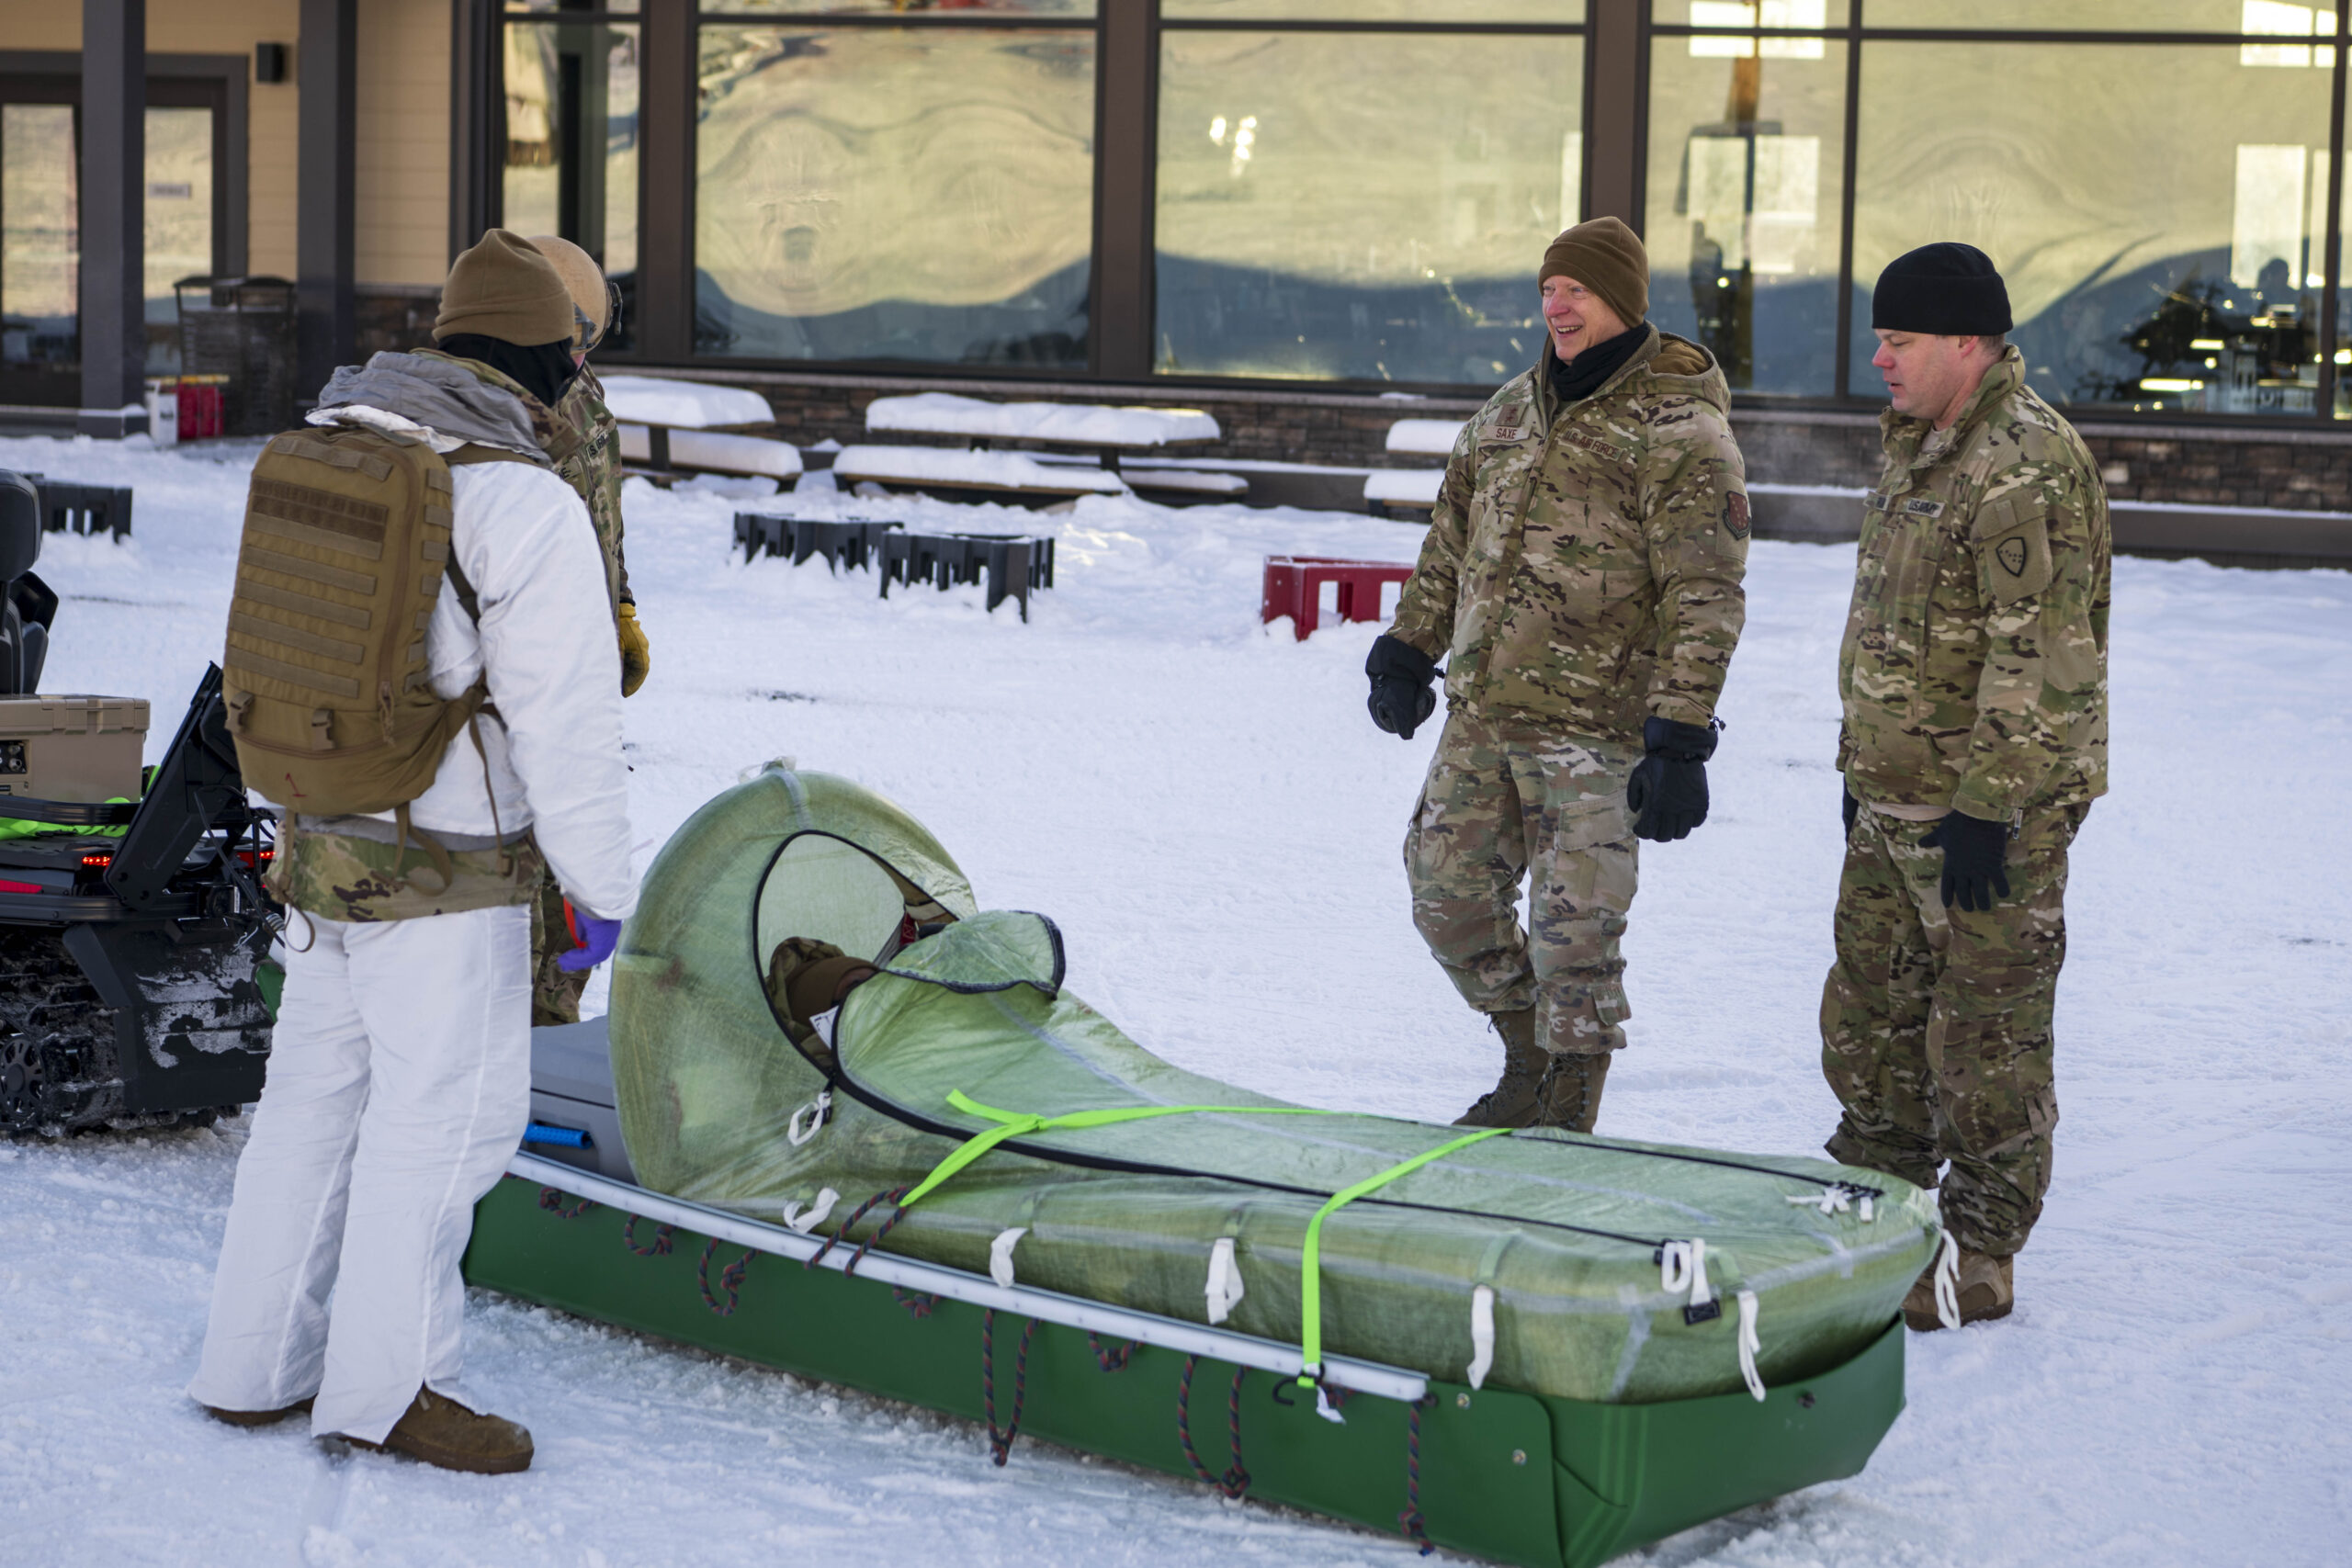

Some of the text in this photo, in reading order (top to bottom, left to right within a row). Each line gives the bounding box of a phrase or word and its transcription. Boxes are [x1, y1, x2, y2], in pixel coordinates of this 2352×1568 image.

[1496, 427, 1518, 440] SAXE
[1579, 435, 1594, 449] AIR
[1592, 440, 1619, 457] FORCE
